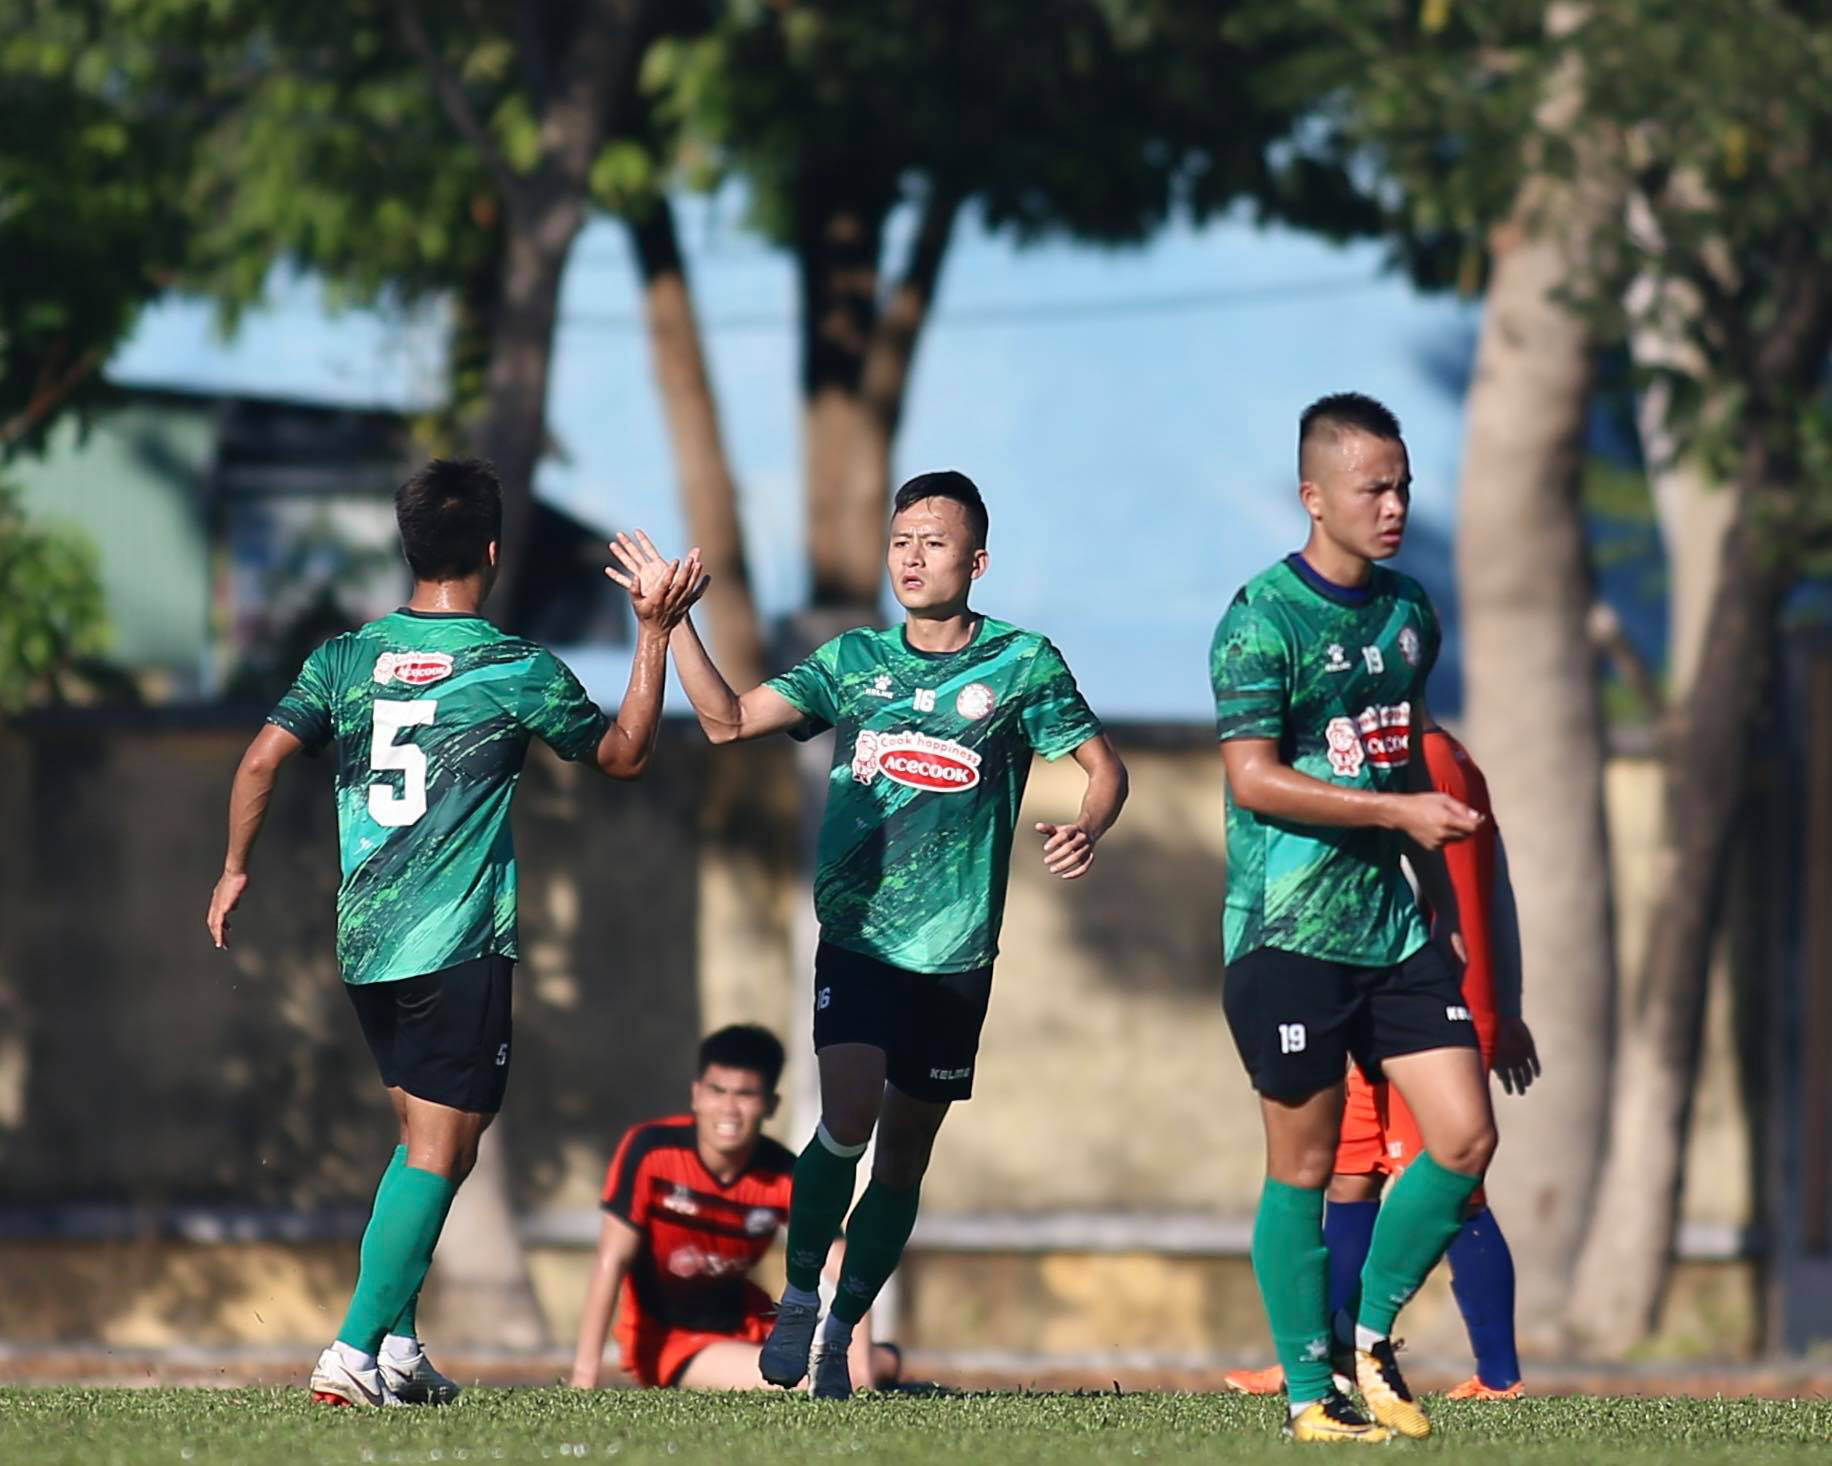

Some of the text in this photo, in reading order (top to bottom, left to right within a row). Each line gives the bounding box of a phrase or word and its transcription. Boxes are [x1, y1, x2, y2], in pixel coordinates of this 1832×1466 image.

[913, 688, 935, 712] 16
[880, 735, 978, 764] Cook happiness
[368, 699, 437, 827] 5
[816, 987, 830, 1011] 16
[1278, 1023, 1306, 1054] 19
[496, 1043, 508, 1066] 5
